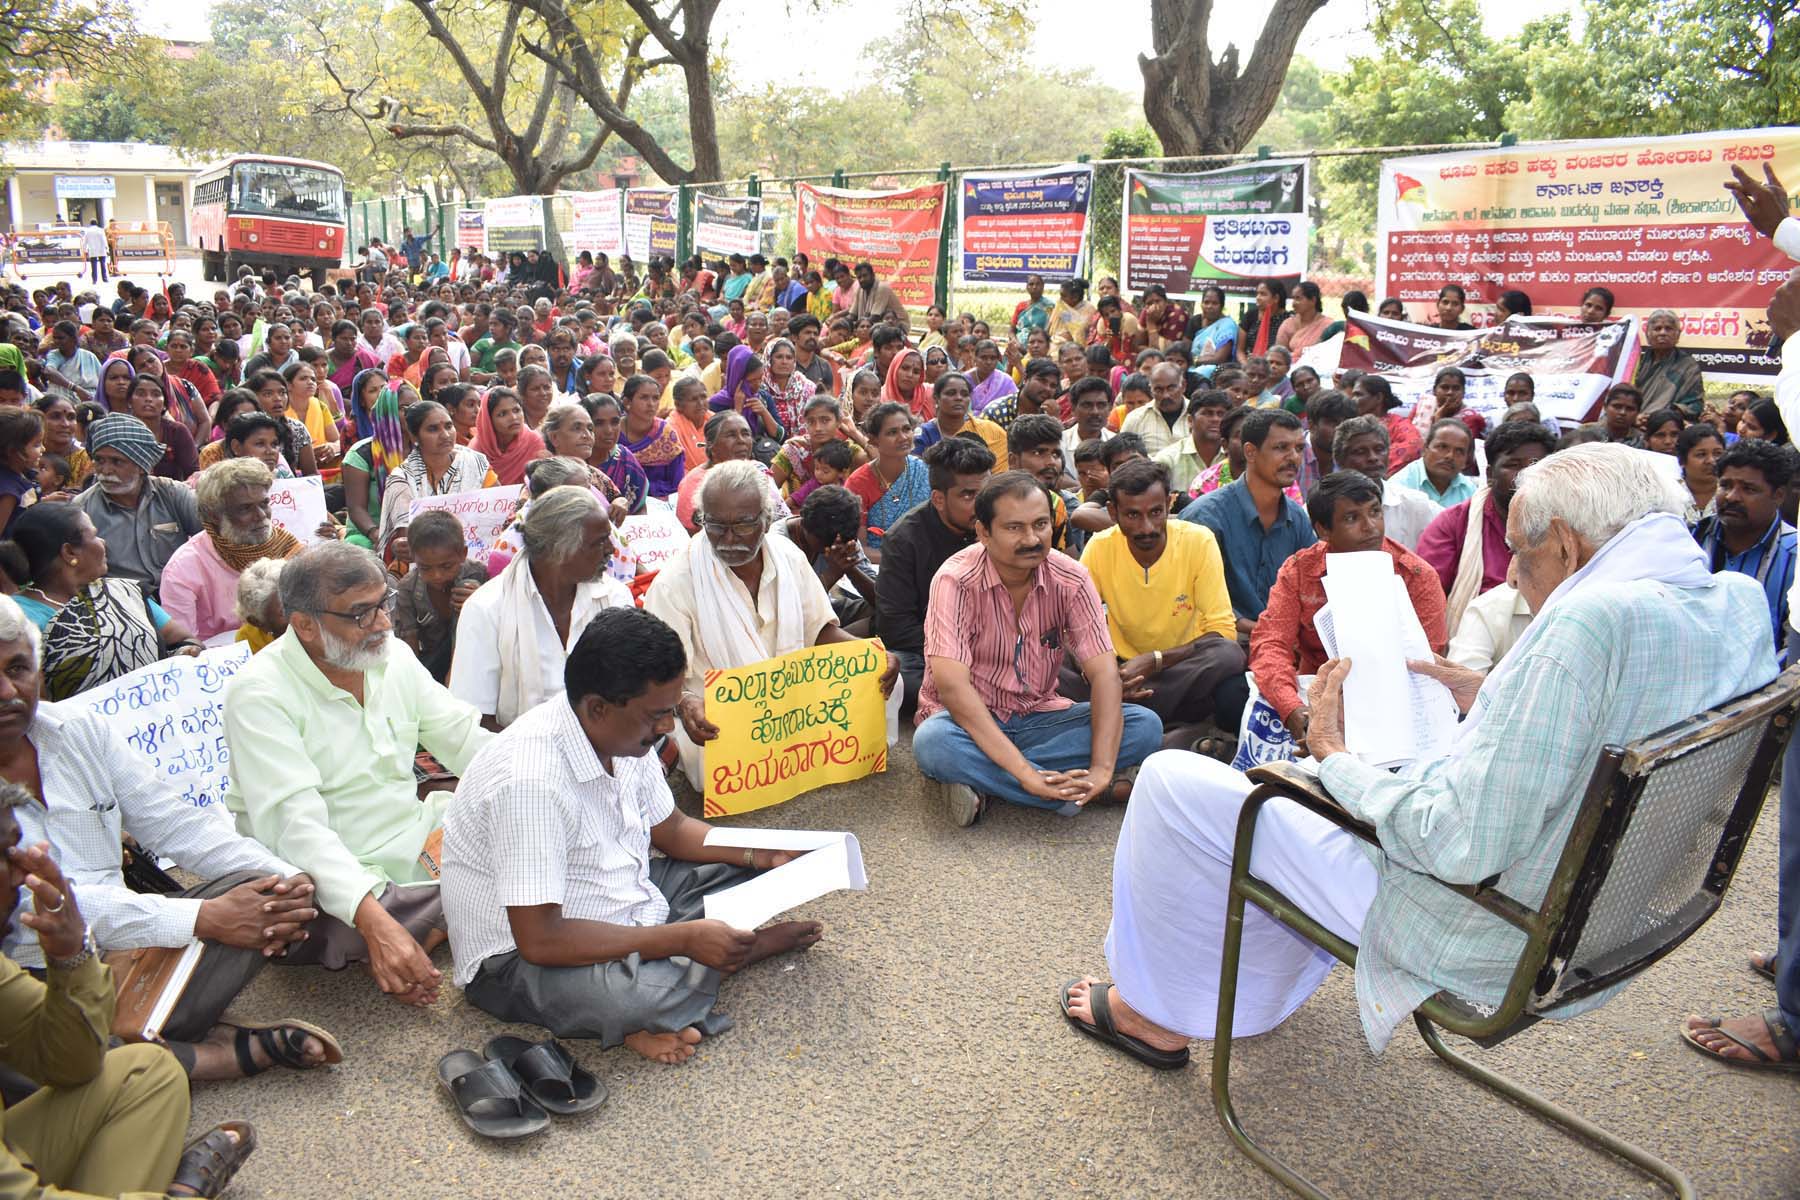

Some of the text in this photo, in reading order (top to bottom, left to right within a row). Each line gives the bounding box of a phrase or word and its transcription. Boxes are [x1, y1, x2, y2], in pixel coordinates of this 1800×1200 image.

[1439, 143, 1776, 181] ಭೂಮಿ ವಸತಿ ಹಕ್ಕು ವಂಚಿತರ ಹೋರಾಟ ಸಮಿತಿ
[1535, 177, 1665, 200] ಕರ್ನಾಟಕ ಜನಶಕ್ತಿ
[1212, 218, 1291, 241] ಪ್ರತಿಭಟನಾ
[1577, 226, 1643, 247] ಸಮುದಾಯಕ್ಕೆ
[1646, 226, 1706, 243] ಮೂಲಭೂತ
[1709, 224, 1751, 246] ಸೌಲಭ್ಯ
[1213, 245, 1289, 266] ಮೆರವಣಿಗೆ
[1508, 250, 1535, 267] ಮತ್ತು
[1536, 249, 1562, 263] ವಸತಿ
[1626, 247, 1669, 263] ಮಾಡಲು
[1660, 269, 1703, 286] ಸರ್ಕಾರಿ
[1706, 268, 1756, 284] ಆದೇಶದ
[715, 671, 767, 709] ಎಲ್ಲಾ
[817, 647, 878, 689] ಶಕ್ತಿಯ
[751, 688, 853, 744] ಹೋರಾಟಕ್ಕೆ
